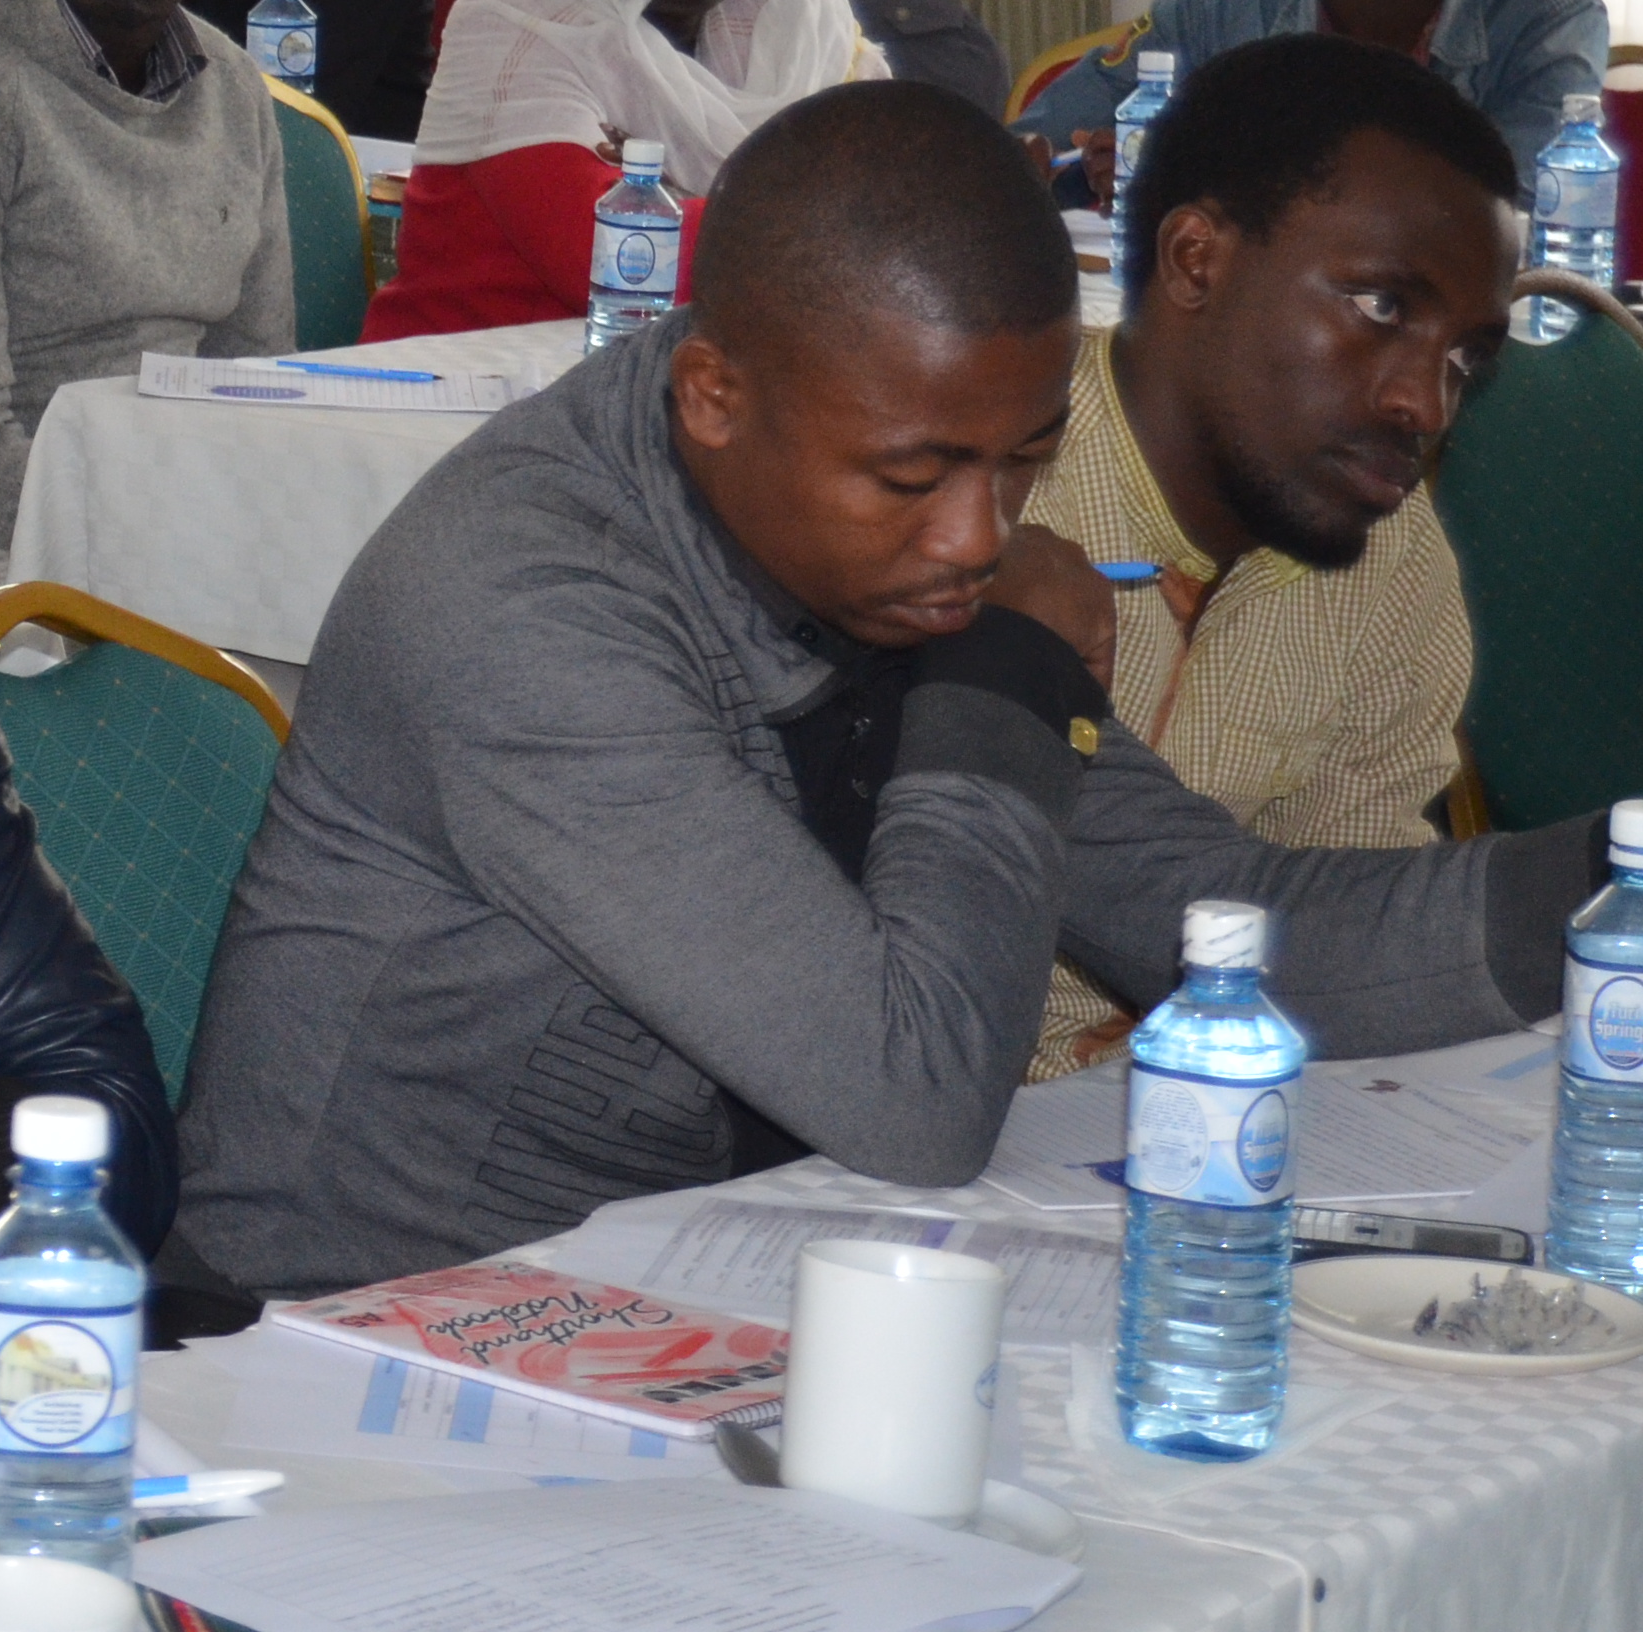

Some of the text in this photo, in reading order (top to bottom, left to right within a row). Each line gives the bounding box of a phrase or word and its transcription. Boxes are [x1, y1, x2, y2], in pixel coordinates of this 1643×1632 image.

[1595, 1018, 1643, 1043] Spring
[337, 1310, 385, 1329] A5
[427, 1290, 598, 1341] Notebook
[462, 1298, 674, 1366] Shorthand
